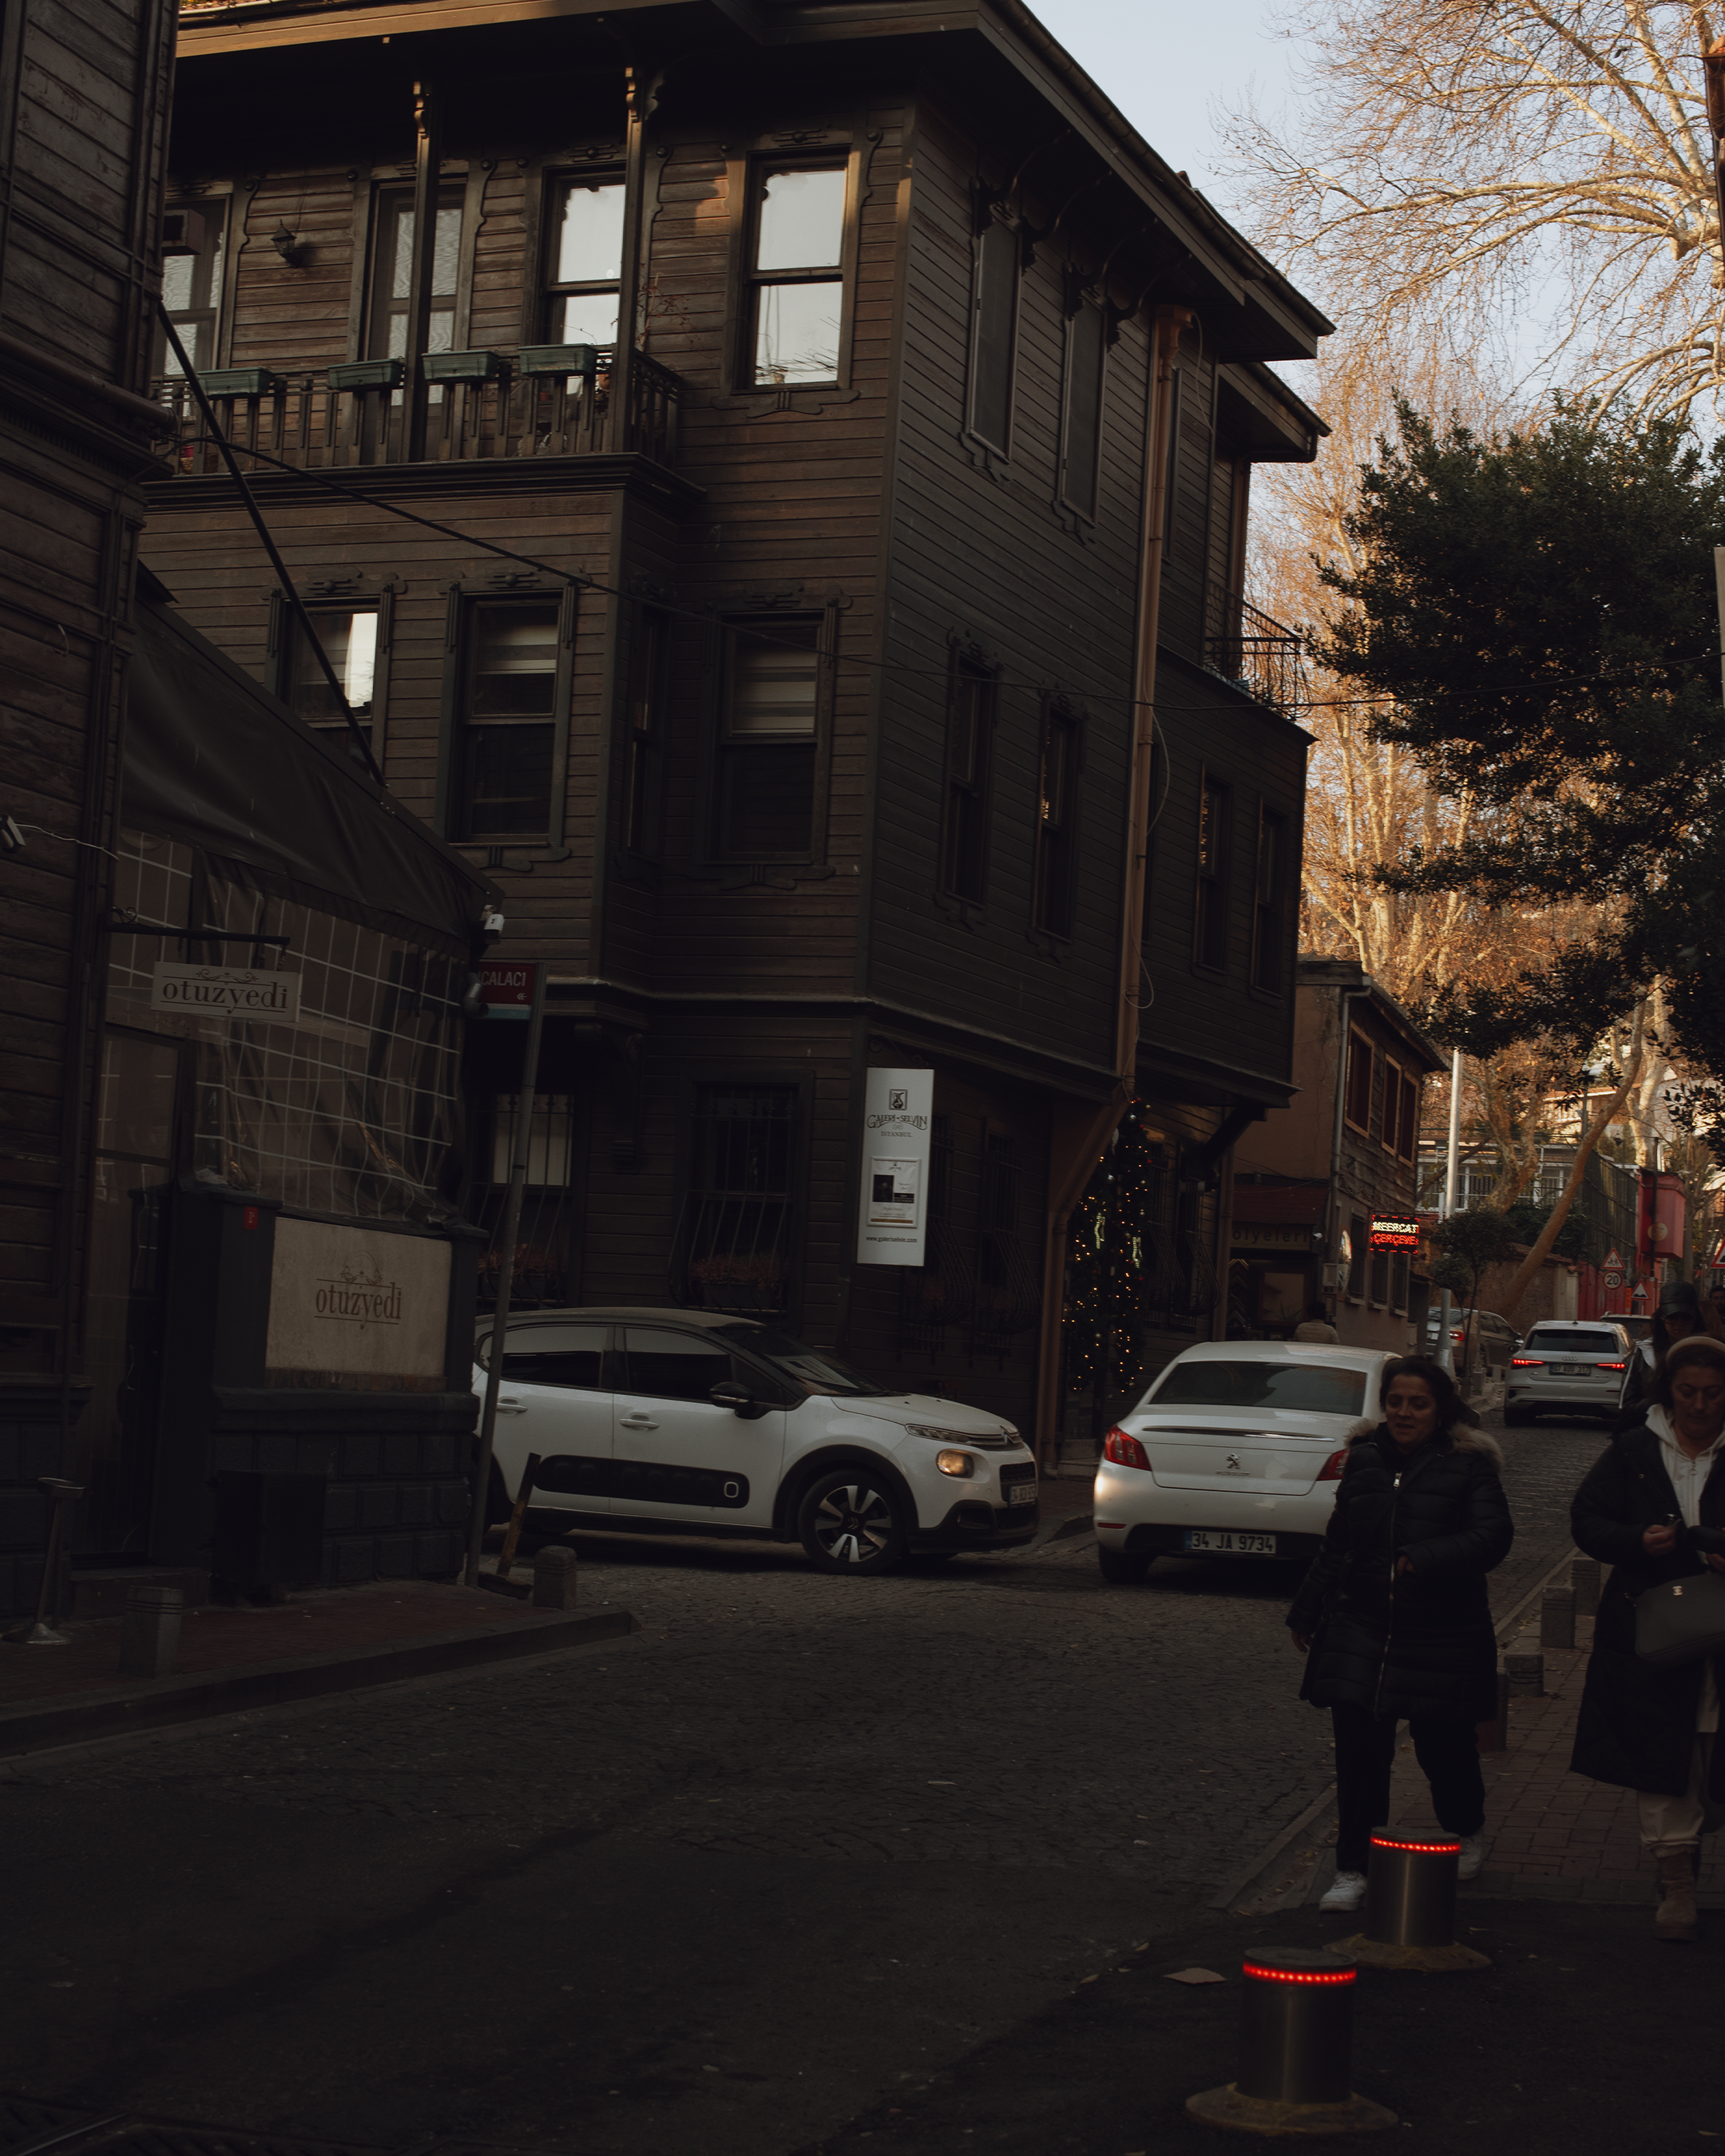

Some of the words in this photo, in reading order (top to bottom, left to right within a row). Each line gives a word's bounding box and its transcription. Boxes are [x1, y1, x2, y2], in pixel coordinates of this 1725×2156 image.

[478, 970, 526, 987] CALACI
[162, 981, 288, 1014] otuzyedi
[1372, 1221, 1419, 1234] MEERCAT
[1607, 1274, 1619, 1286] 20
[315, 1282, 402, 1330] otuzyedi
[1193, 1532, 1209, 1548] 34
[1216, 1534, 1232, 1549] JA
[1239, 1535, 1273, 1552] 9734
